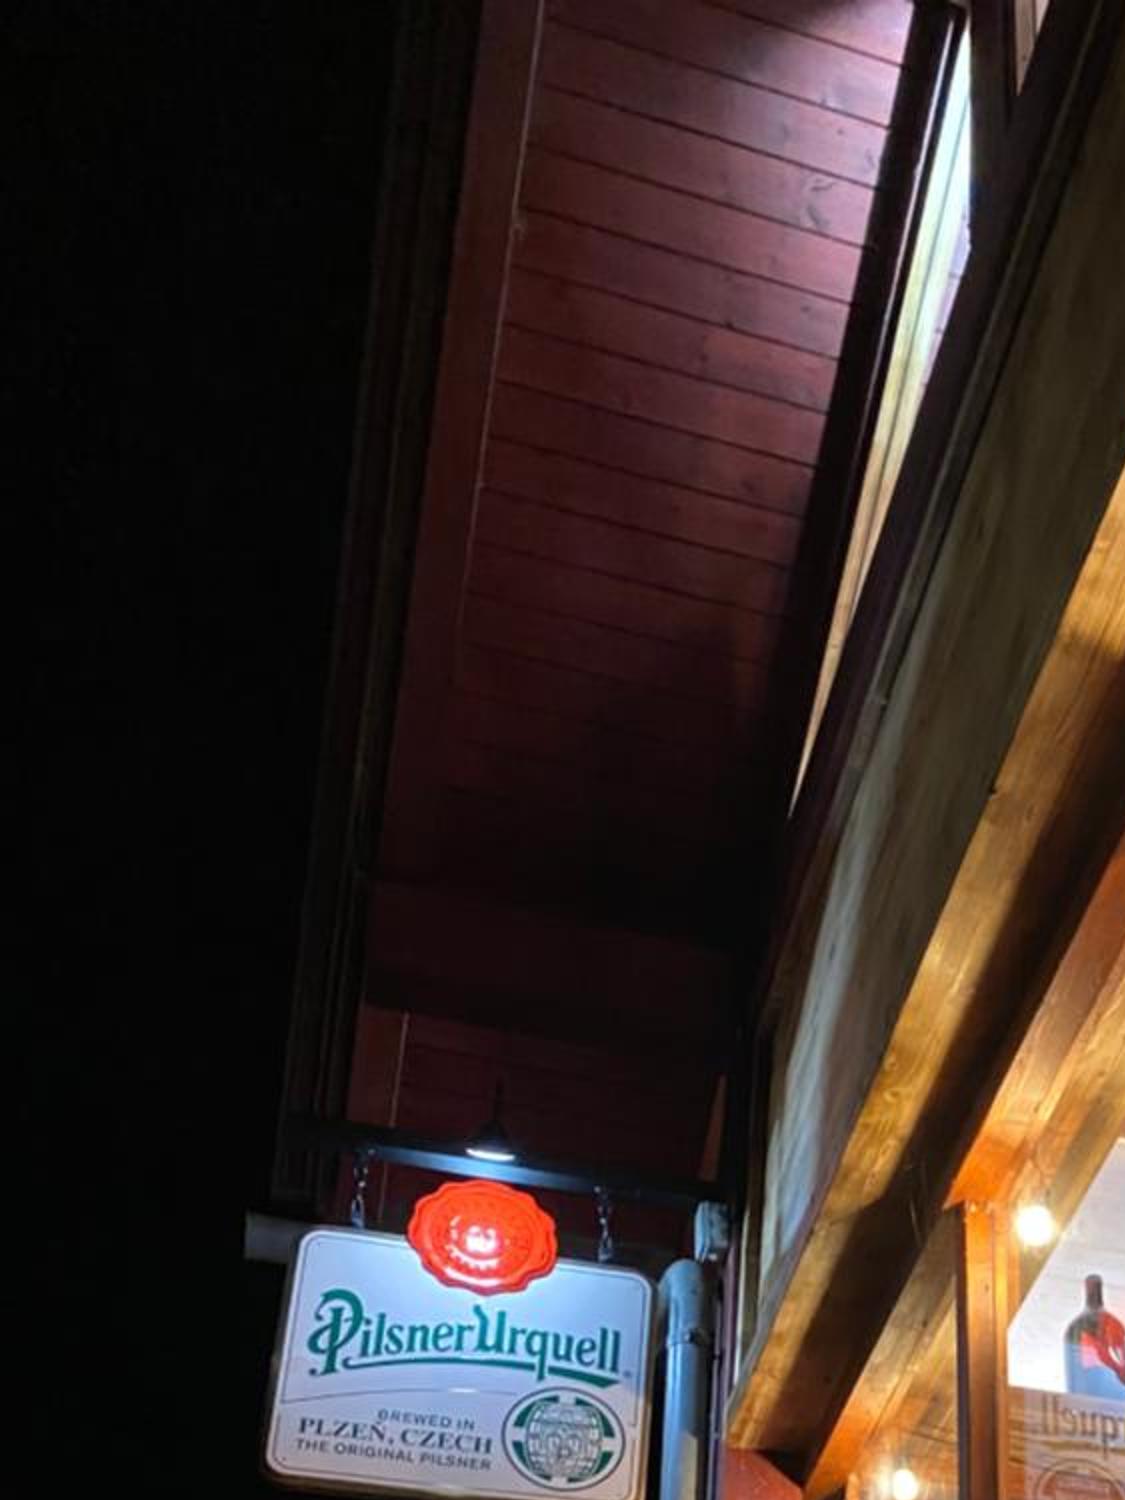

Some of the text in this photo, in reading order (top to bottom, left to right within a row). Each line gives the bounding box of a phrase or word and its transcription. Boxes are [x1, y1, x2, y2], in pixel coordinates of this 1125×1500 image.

[307, 1289, 621, 1382] Pilsner Urquell
[378, 1408, 475, 1431] BREWED IN
[297, 1439, 491, 1471] THE ORIGINAL PILSNER
[401, 1428, 493, 1454] CZECH
